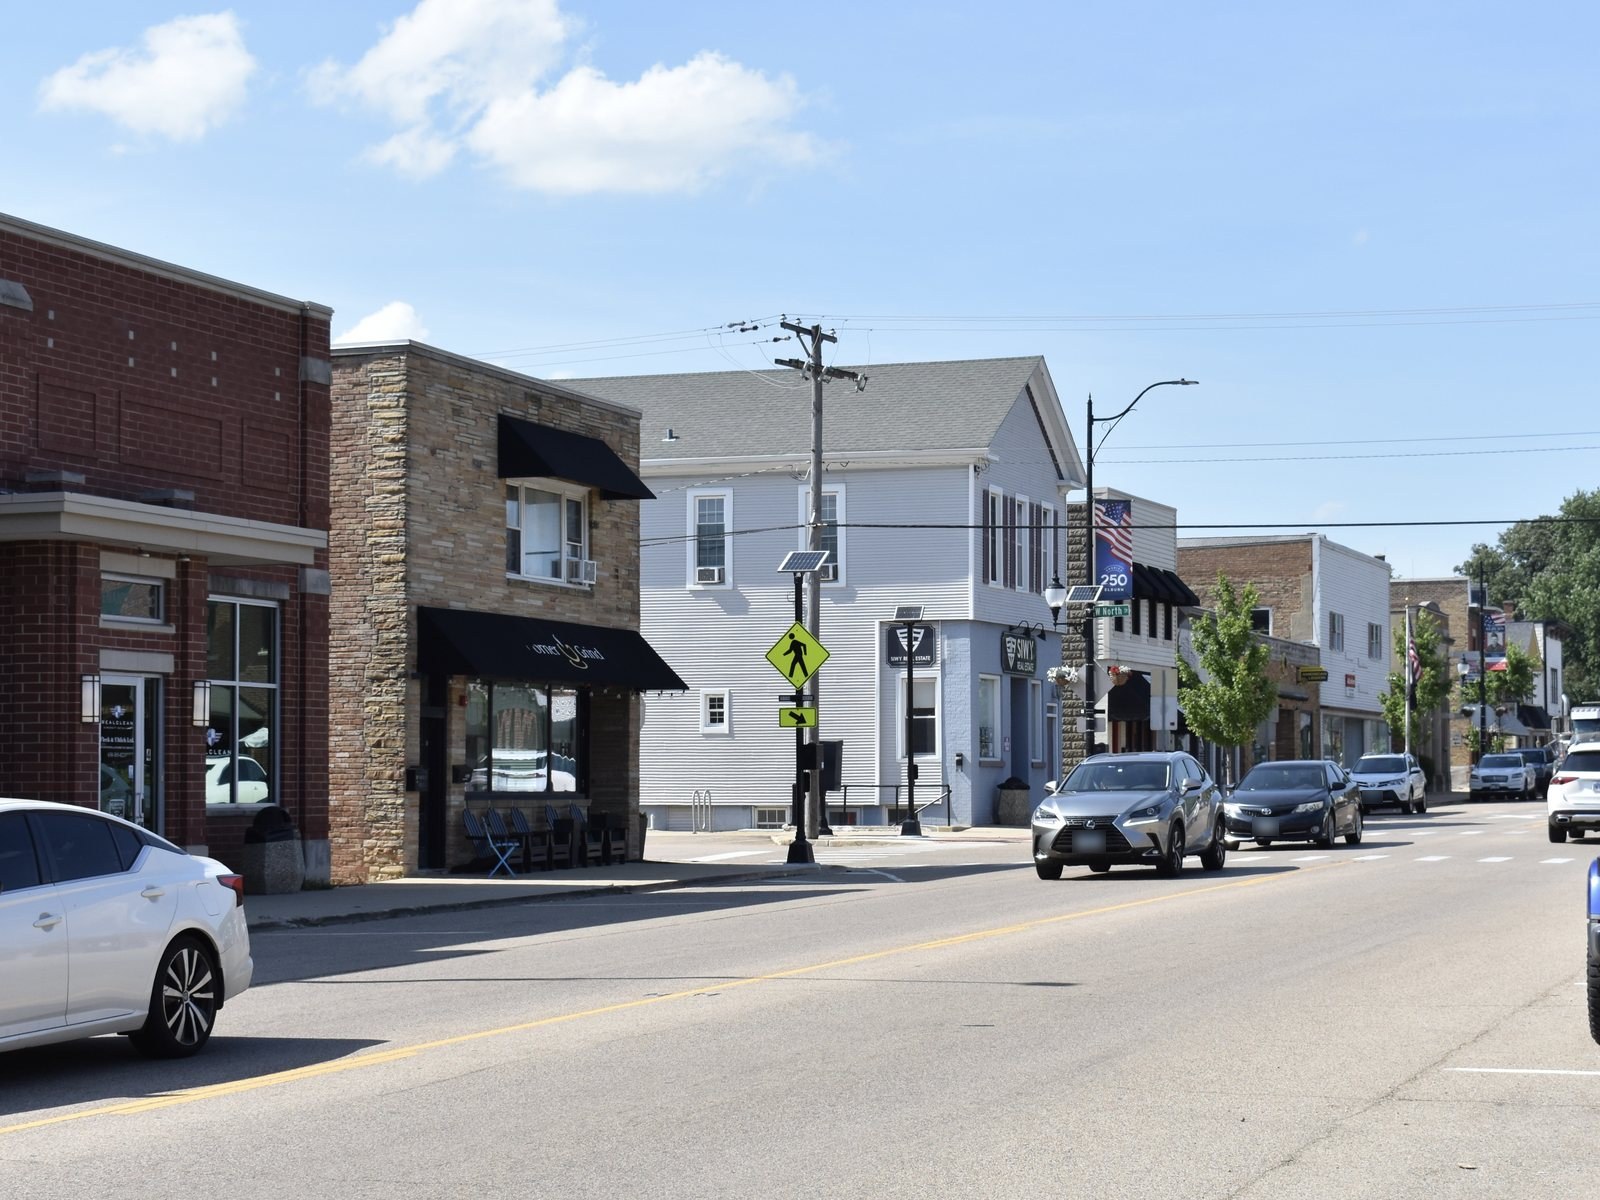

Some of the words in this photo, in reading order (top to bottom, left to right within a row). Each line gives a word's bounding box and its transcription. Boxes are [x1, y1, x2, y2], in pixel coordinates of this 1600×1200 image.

[1101, 574, 1127, 586] 250
[1095, 607, 1100, 616] W
[1102, 607, 1123, 615] North
[525, 643, 560, 655] orner
[574, 645, 604, 659] Grind
[1017, 638, 1034, 660] SIWY
[1025, 662, 1034, 672] ESTATE
